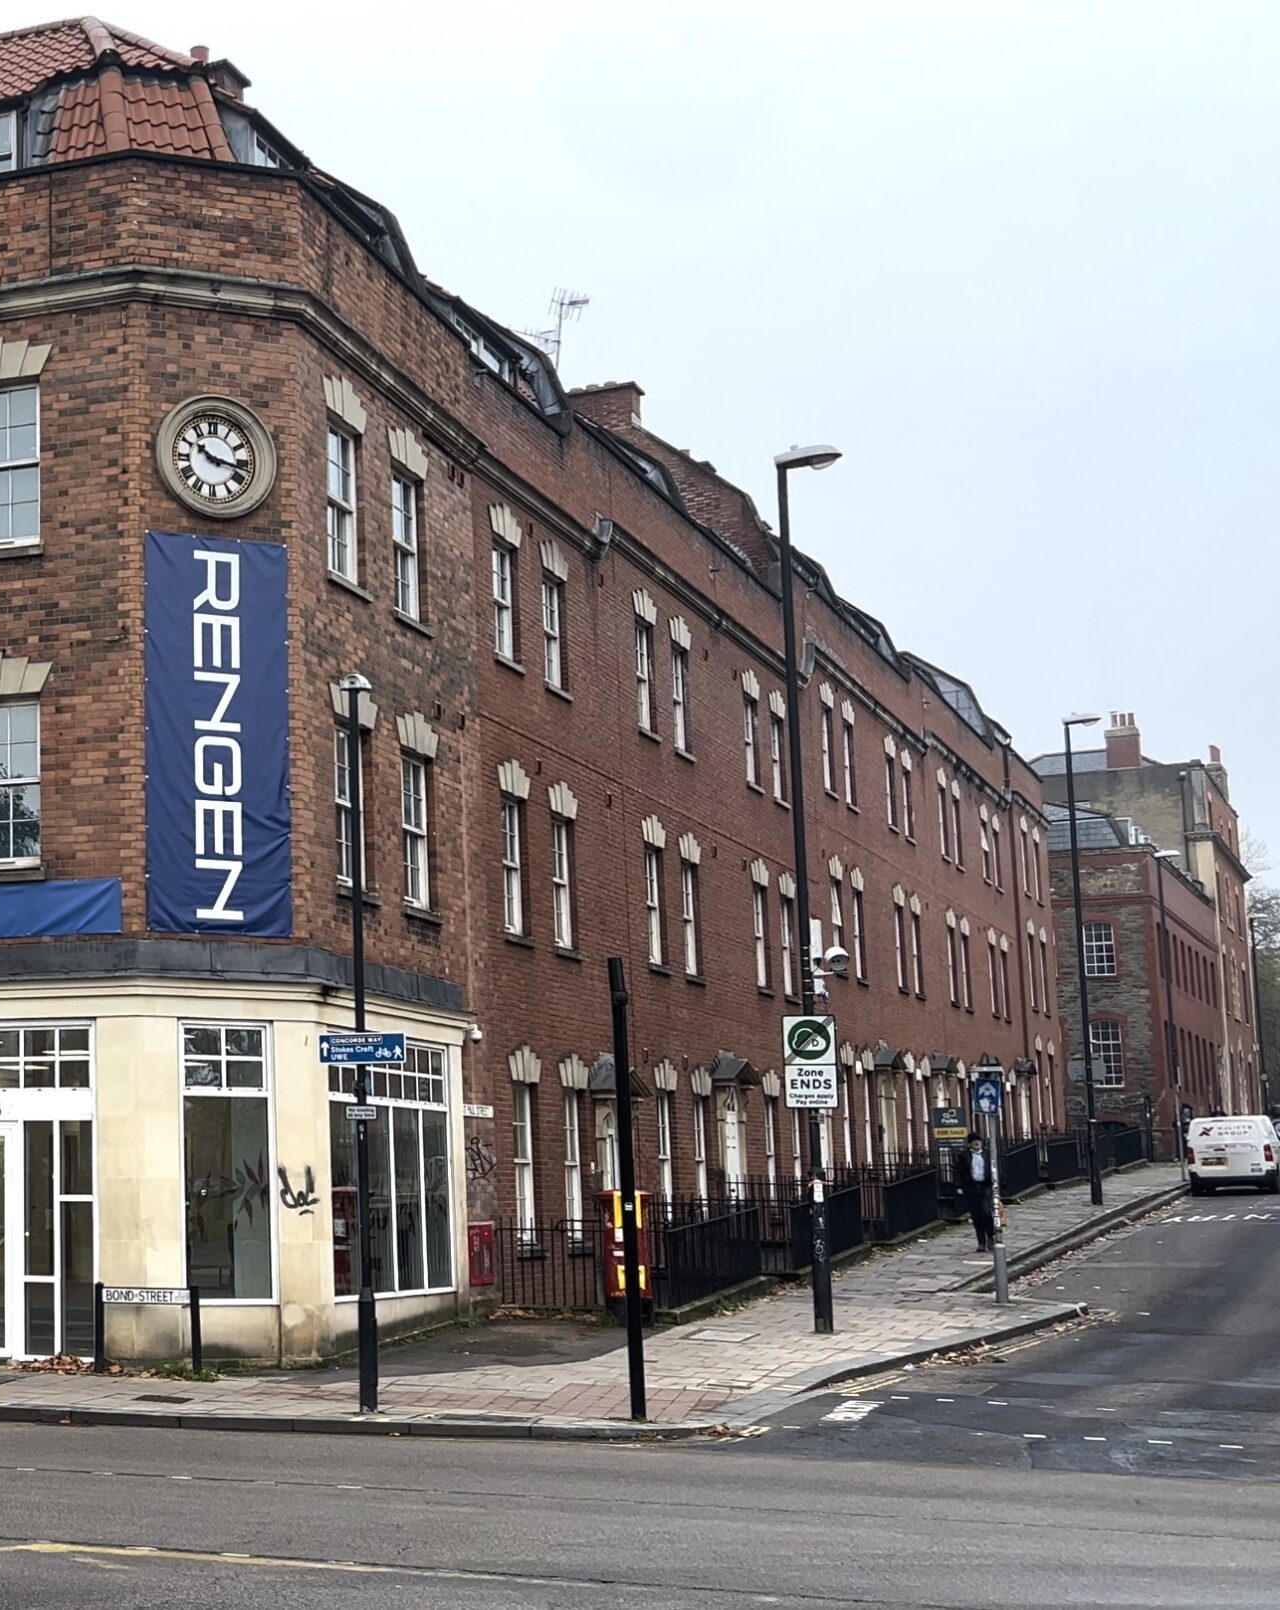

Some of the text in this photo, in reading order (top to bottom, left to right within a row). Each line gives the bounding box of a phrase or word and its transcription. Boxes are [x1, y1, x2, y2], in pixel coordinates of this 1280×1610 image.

[193, 549, 244, 921] RENGEN
[812, 1039, 819, 1047] D
[797, 1068, 824, 1077] Zone
[790, 1079, 832, 1090] ENDS
[105, 1289, 135, 1301] BOND
[138, 1290, 174, 1302] STREET
